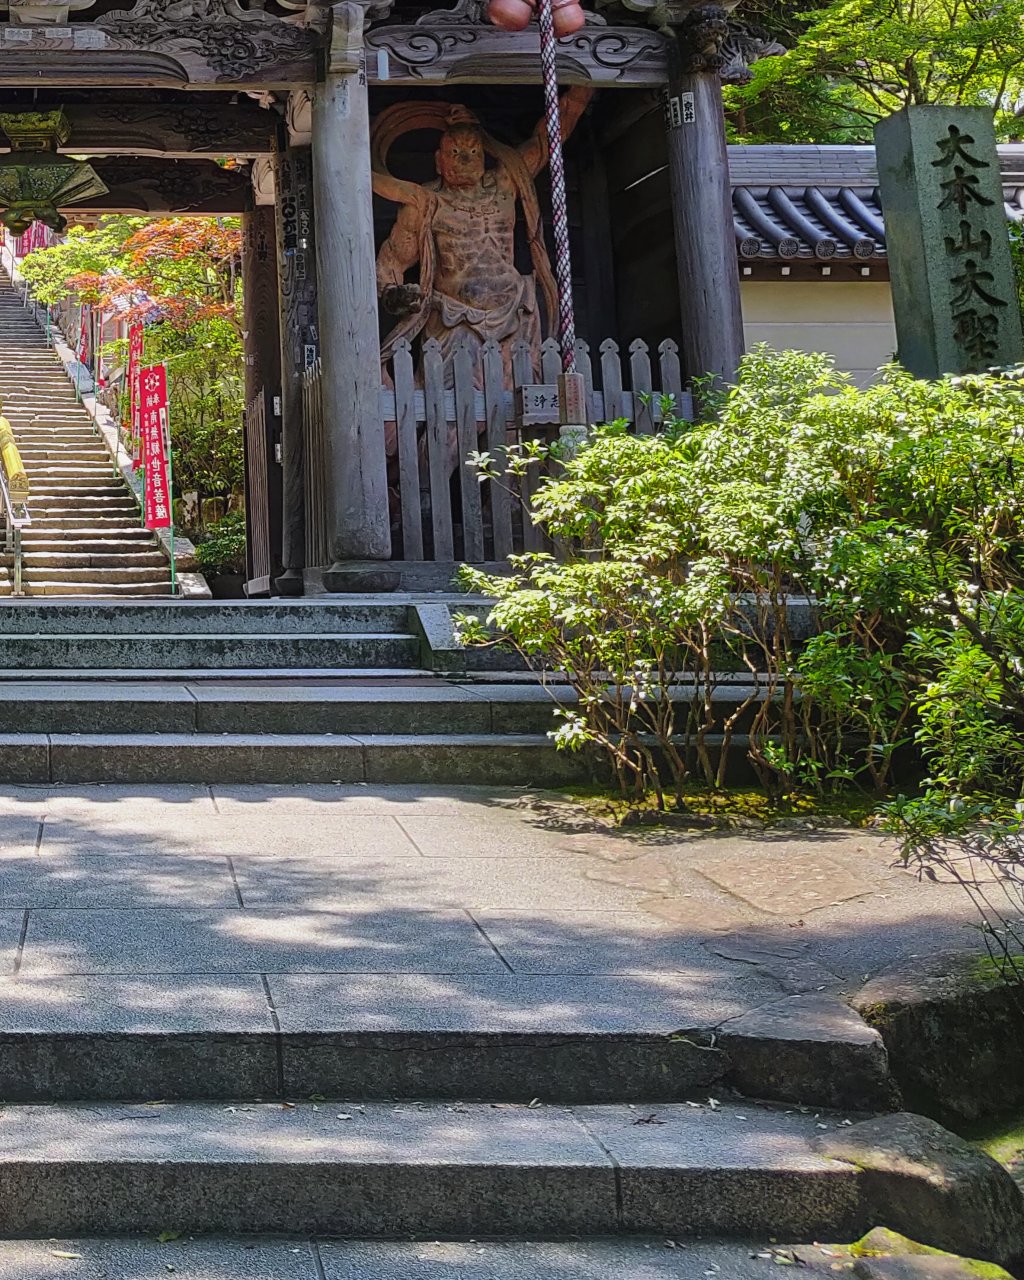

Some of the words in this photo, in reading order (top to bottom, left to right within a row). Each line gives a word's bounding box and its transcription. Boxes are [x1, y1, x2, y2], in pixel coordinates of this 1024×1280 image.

[930, 124, 1009, 374] 大本山大聖
